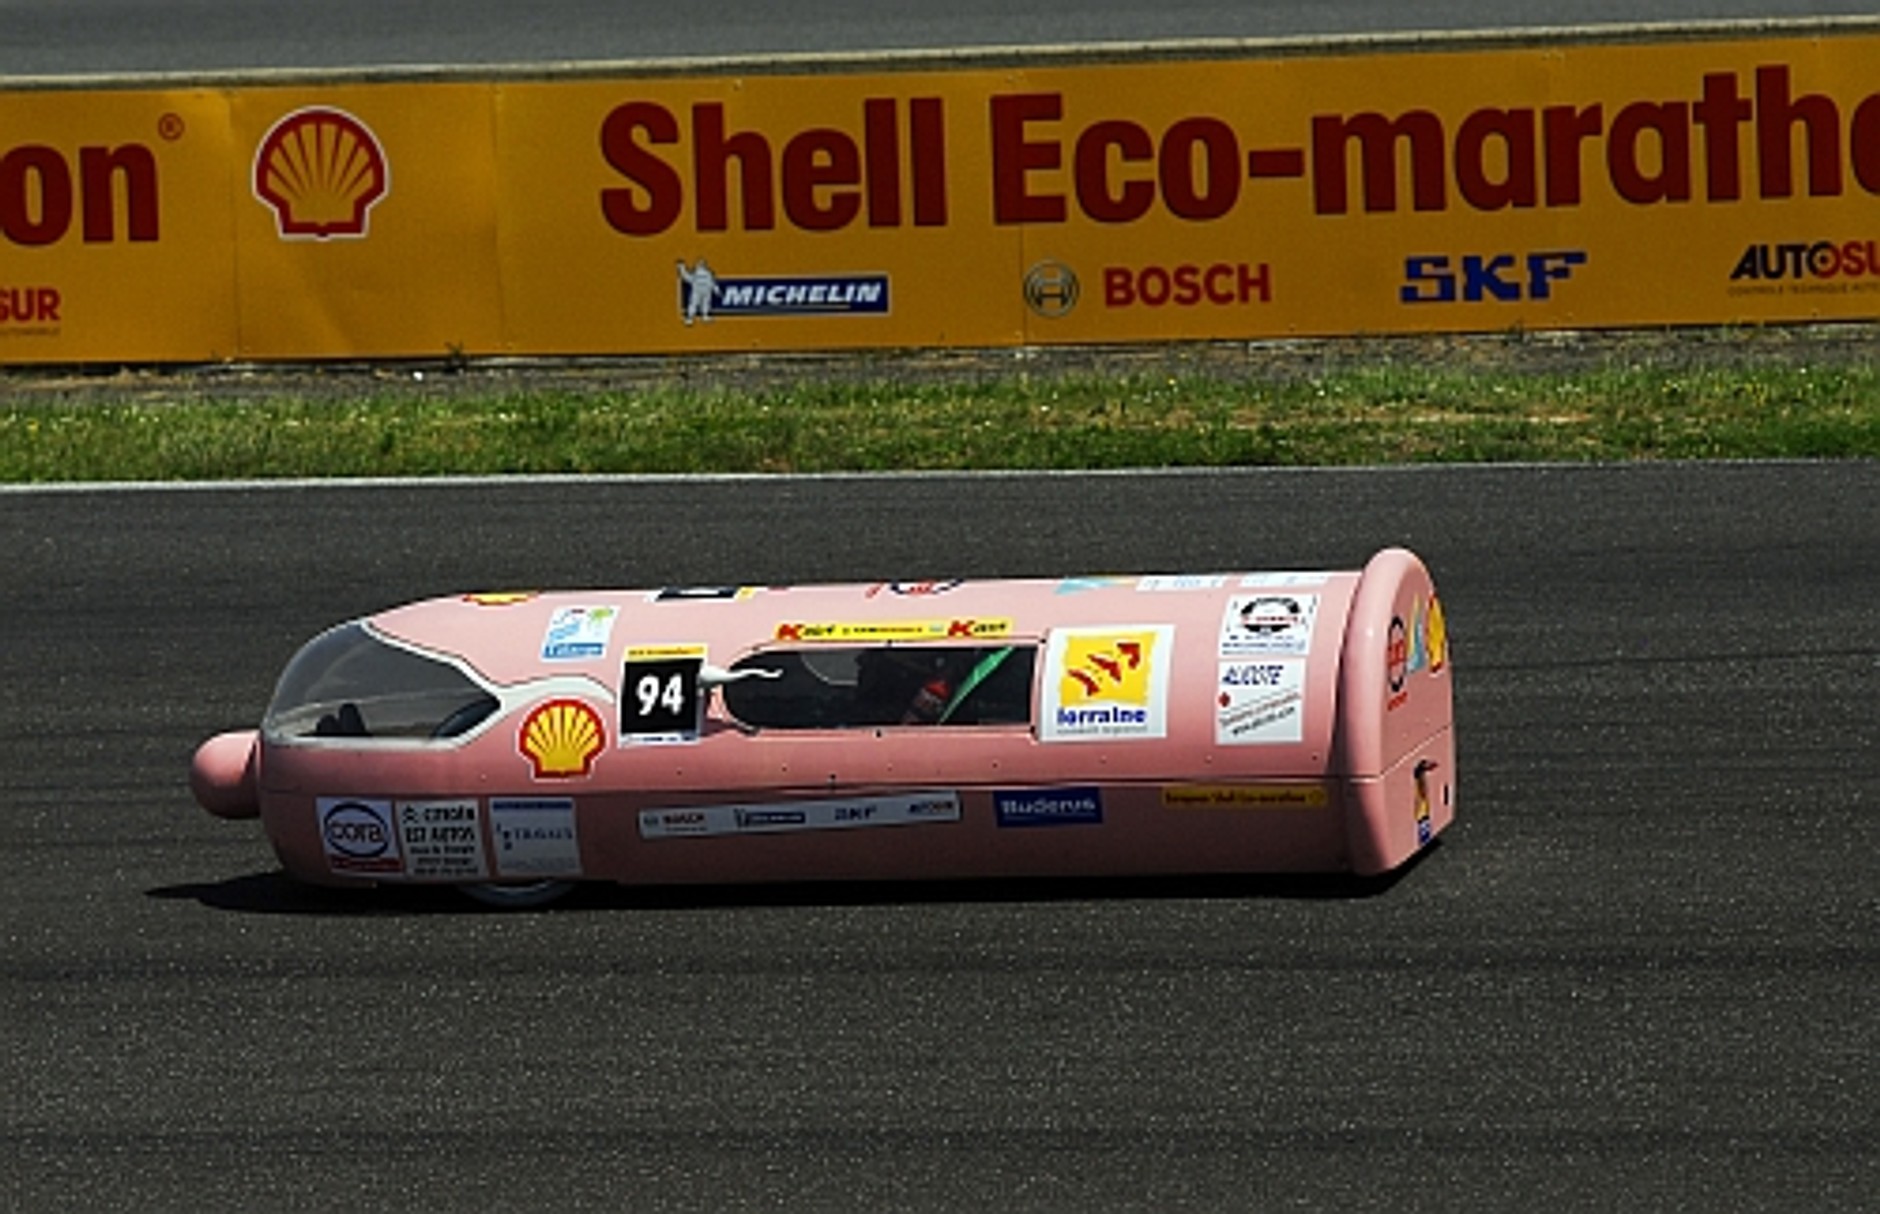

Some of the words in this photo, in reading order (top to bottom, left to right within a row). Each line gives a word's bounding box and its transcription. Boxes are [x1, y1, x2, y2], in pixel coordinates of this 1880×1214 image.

[599, 97, 947, 237] Shell
[720, 282, 883, 306] MICHELIN
[1103, 263, 1272, 307] BOSCH
[1400, 251, 1588, 303] SKF
[636, 672, 686, 716] 94
[1057, 706, 1147, 726] lorraine
[330, 821, 385, 843] cora
